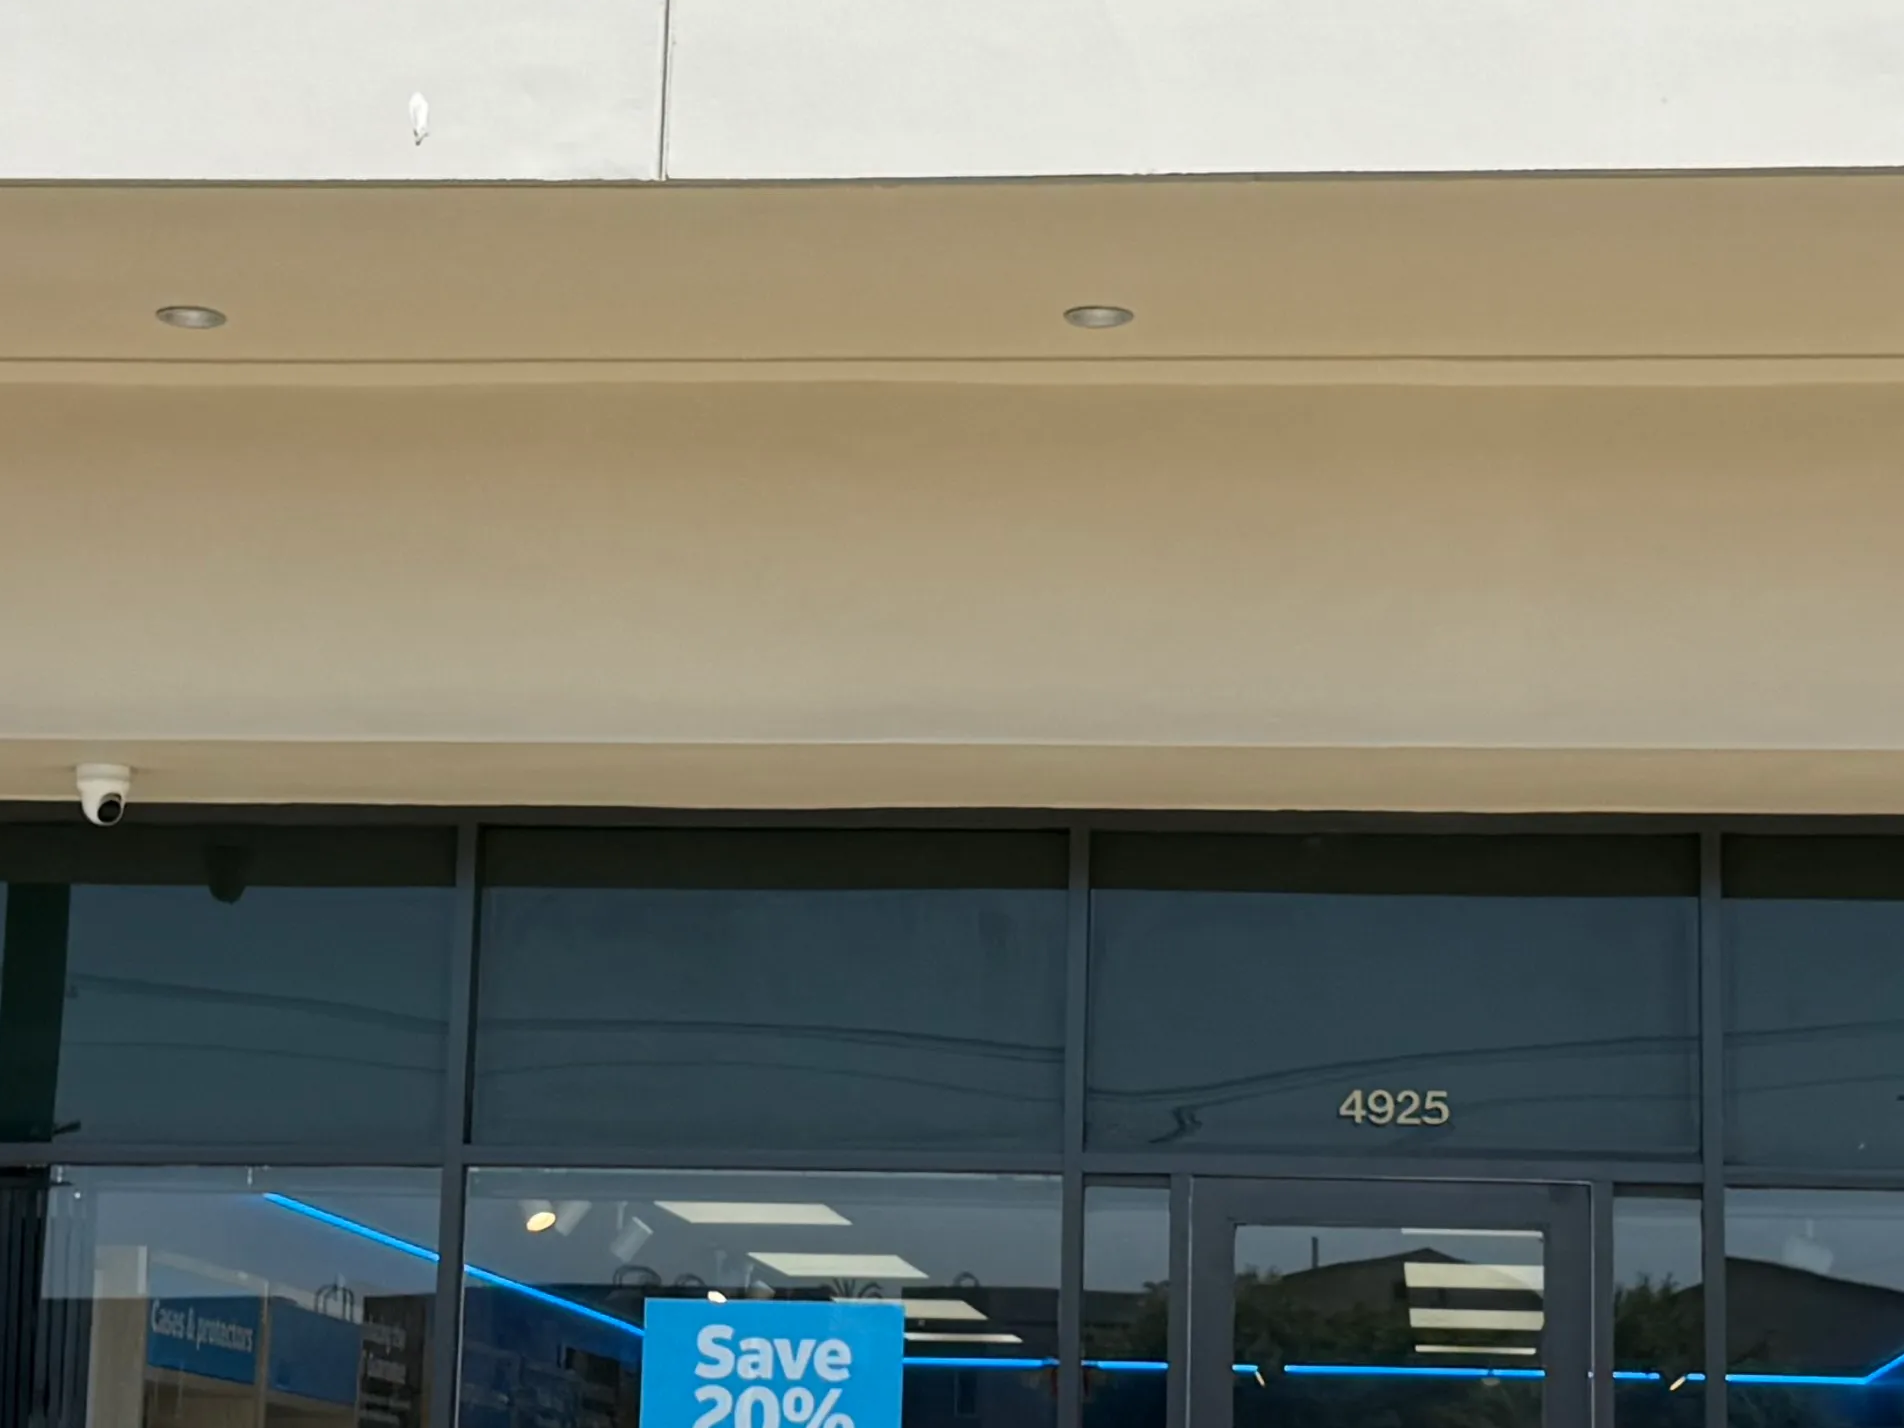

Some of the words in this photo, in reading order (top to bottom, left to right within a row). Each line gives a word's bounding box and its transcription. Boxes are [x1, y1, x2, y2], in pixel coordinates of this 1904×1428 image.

[1339, 1089, 1450, 1125] 4925
[151, 1300, 184, 1338] Cases
[197, 1316, 253, 1352] protectors
[694, 1324, 852, 1382] Save
